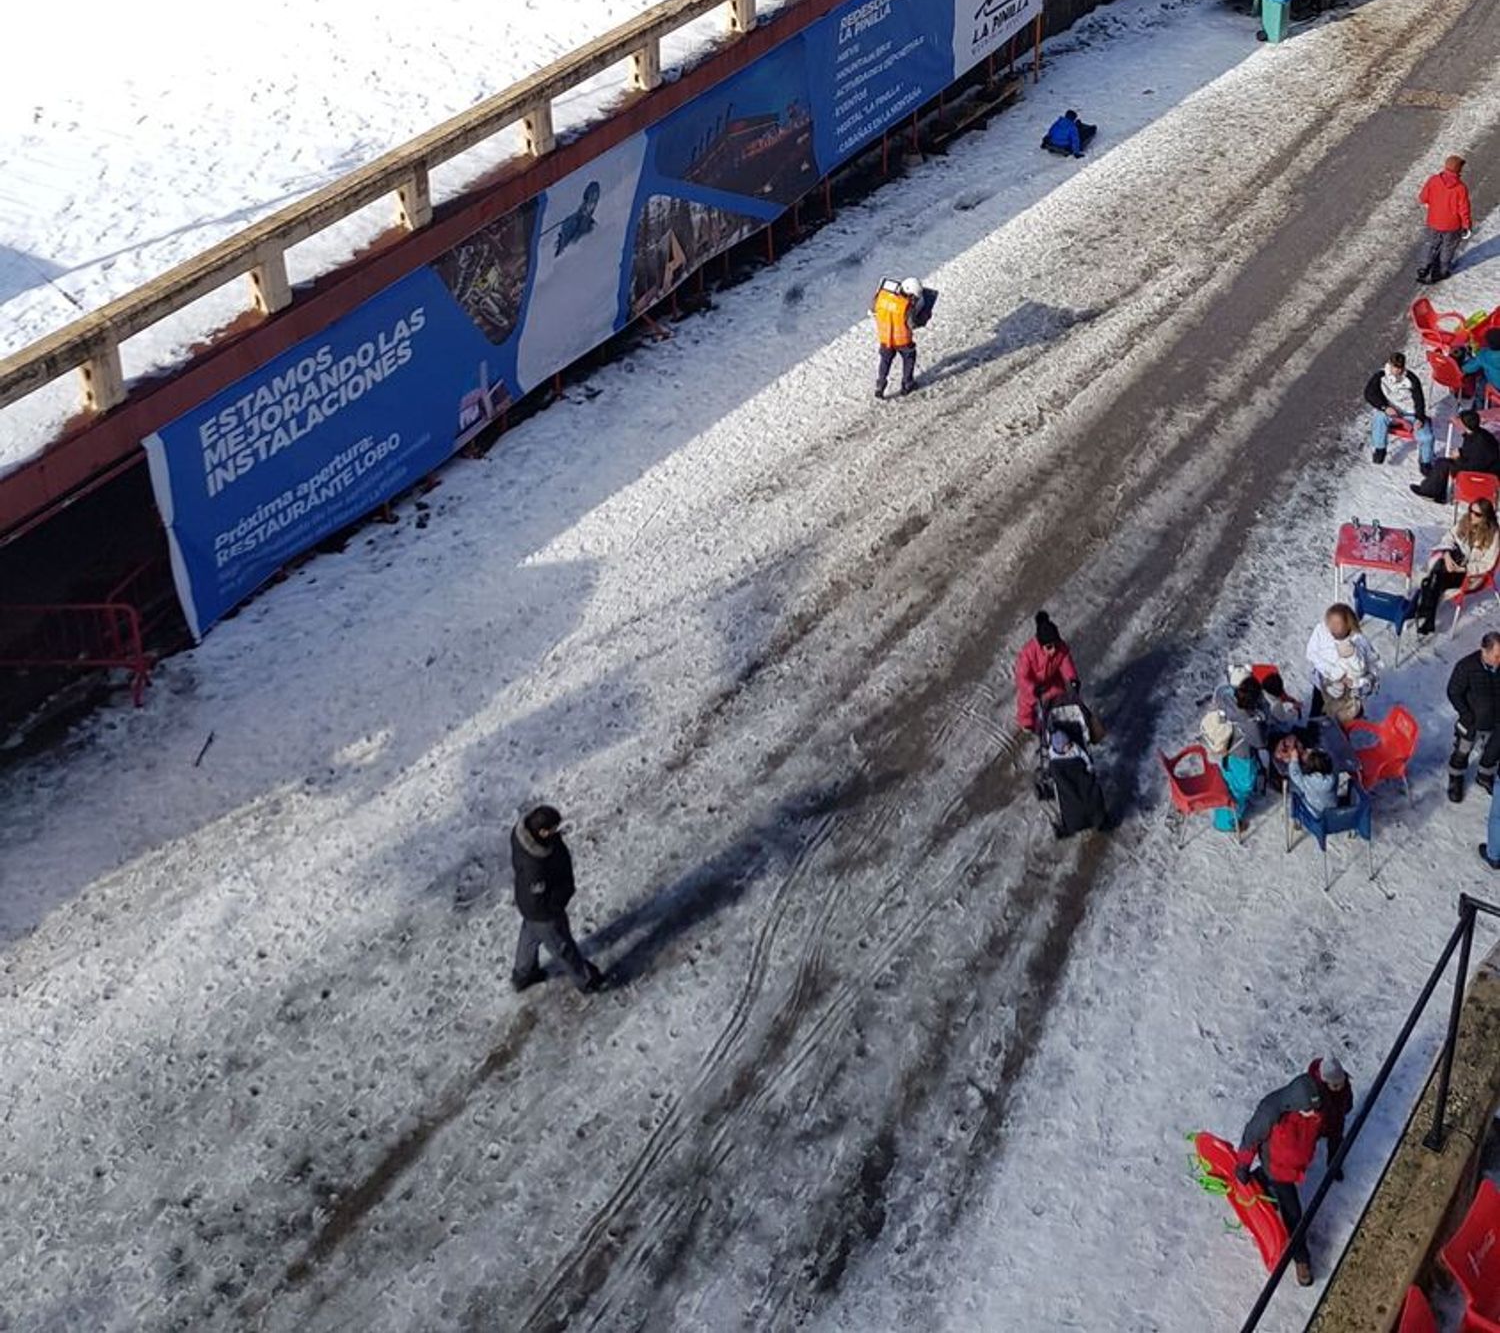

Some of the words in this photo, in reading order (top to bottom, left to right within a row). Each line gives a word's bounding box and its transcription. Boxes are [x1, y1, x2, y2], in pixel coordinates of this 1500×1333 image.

[839, 24, 852, 44] LA
[973, 22, 989, 44] LA
[199, 344, 333, 449] ESTAMOS
[203, 342, 375, 473] MEJORANDO
[378, 306, 426, 354] LAS
[206, 339, 413, 498] INSTALACIONES
[214, 490, 294, 551] Próxima
[296, 434, 374, 497] apertura:
[217, 469, 355, 568] RESTAURANTE
[356, 432, 401, 476] LOBO
